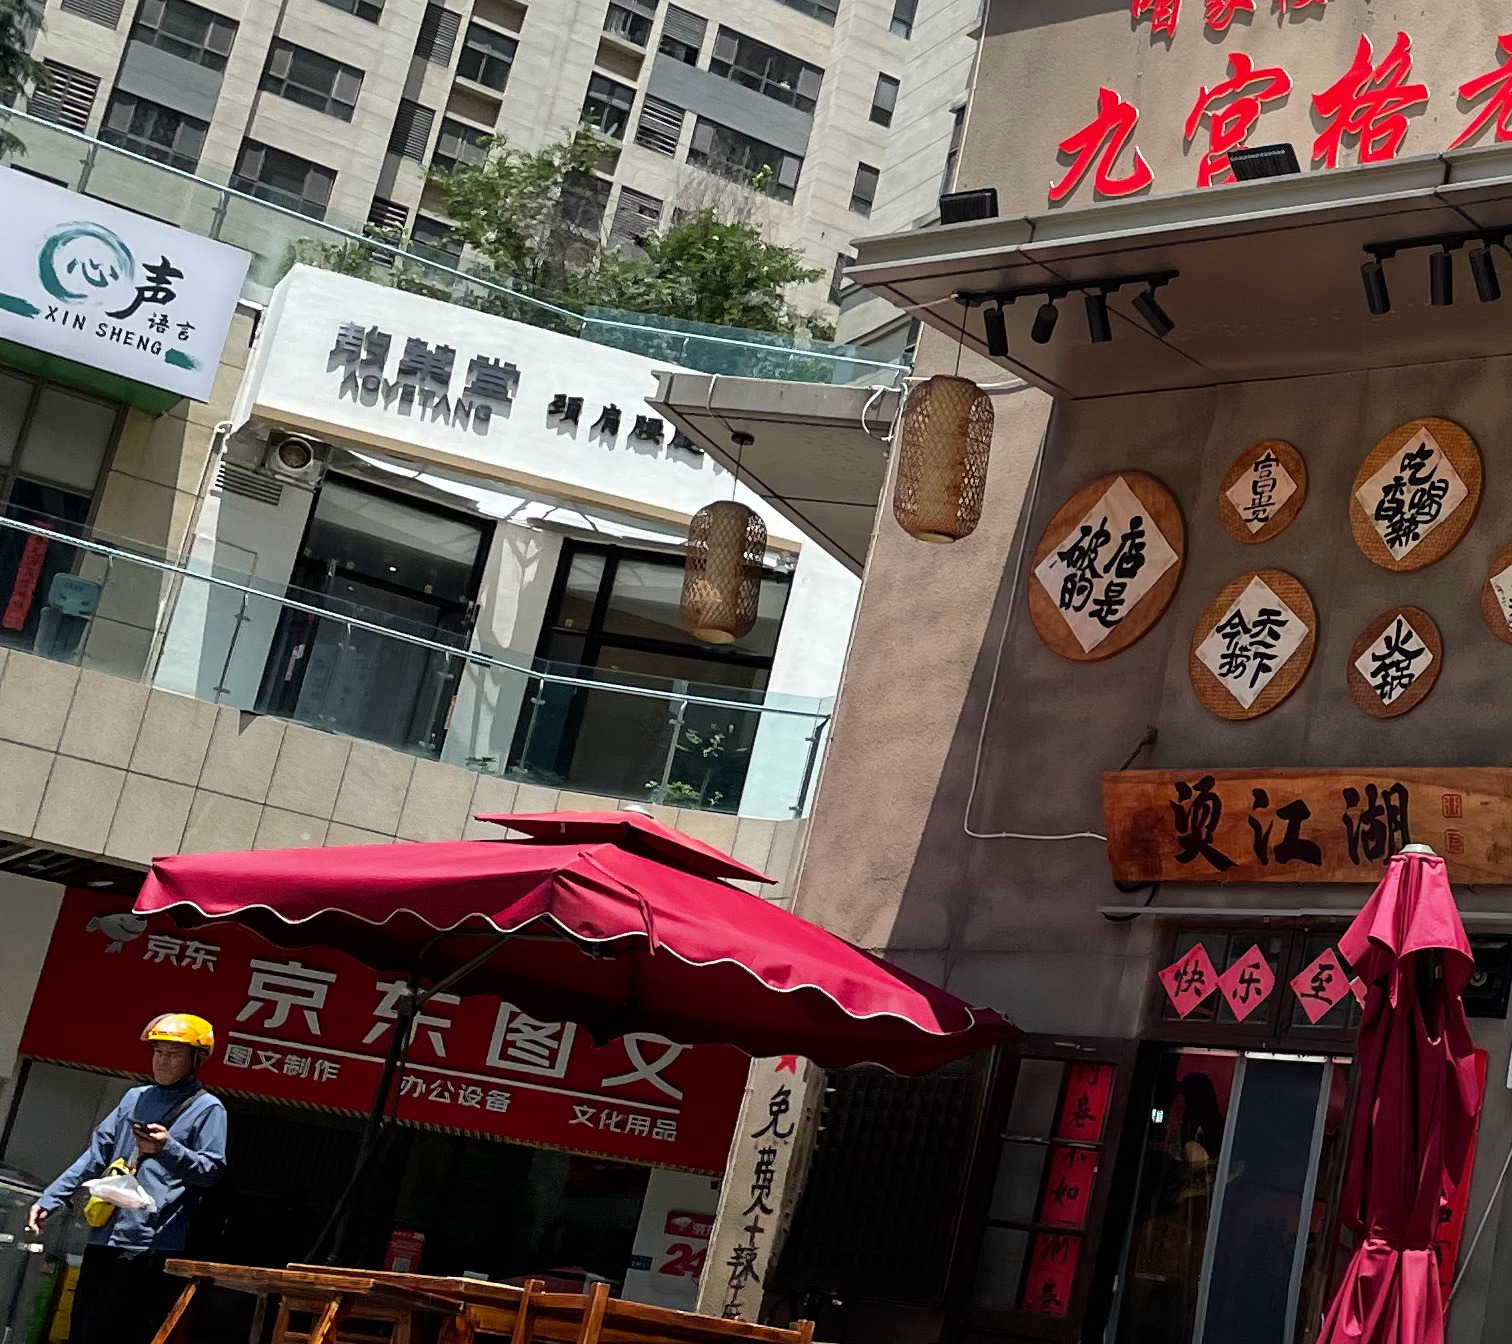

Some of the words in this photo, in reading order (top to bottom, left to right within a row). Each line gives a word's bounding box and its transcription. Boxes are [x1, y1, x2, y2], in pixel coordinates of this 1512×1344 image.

[45, 305, 87, 330] XIN
[95, 323, 162, 355] SHENG
[148, 312, 196, 341] 语言
[1242, 452, 1280, 523] 富贵
[1371, 618, 1425, 700] 火锅
[1170, 775, 1410, 872] 烫江湖
[143, 935, 220, 973] 京东
[236, 959, 694, 1101] 京东图文
[223, 1044, 341, 1082] 图文制作
[400, 1075, 510, 1113] 办公设备
[569, 1105, 677, 1142] 文化用品
